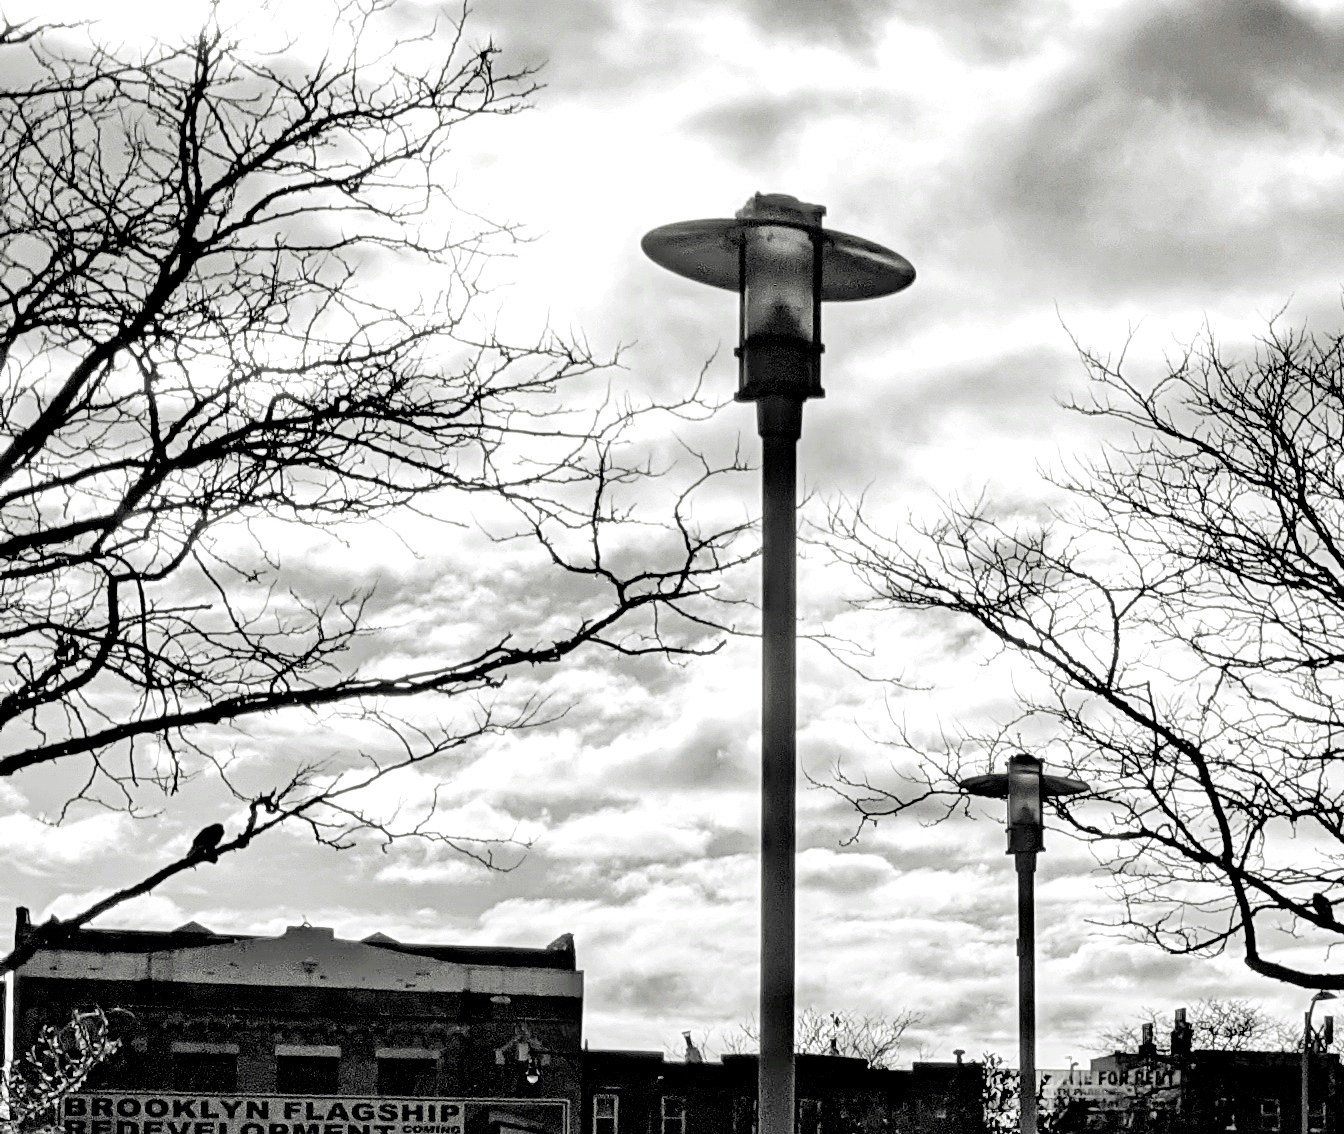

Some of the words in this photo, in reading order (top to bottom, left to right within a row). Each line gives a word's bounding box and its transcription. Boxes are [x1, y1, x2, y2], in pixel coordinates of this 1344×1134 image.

[1098, 1070, 1128, 1086] FOR
[65, 1098, 269, 1119] BROOKLYN
[284, 1102, 460, 1122] FLAGSHIP
[402, 1125, 461, 1134] COMING
